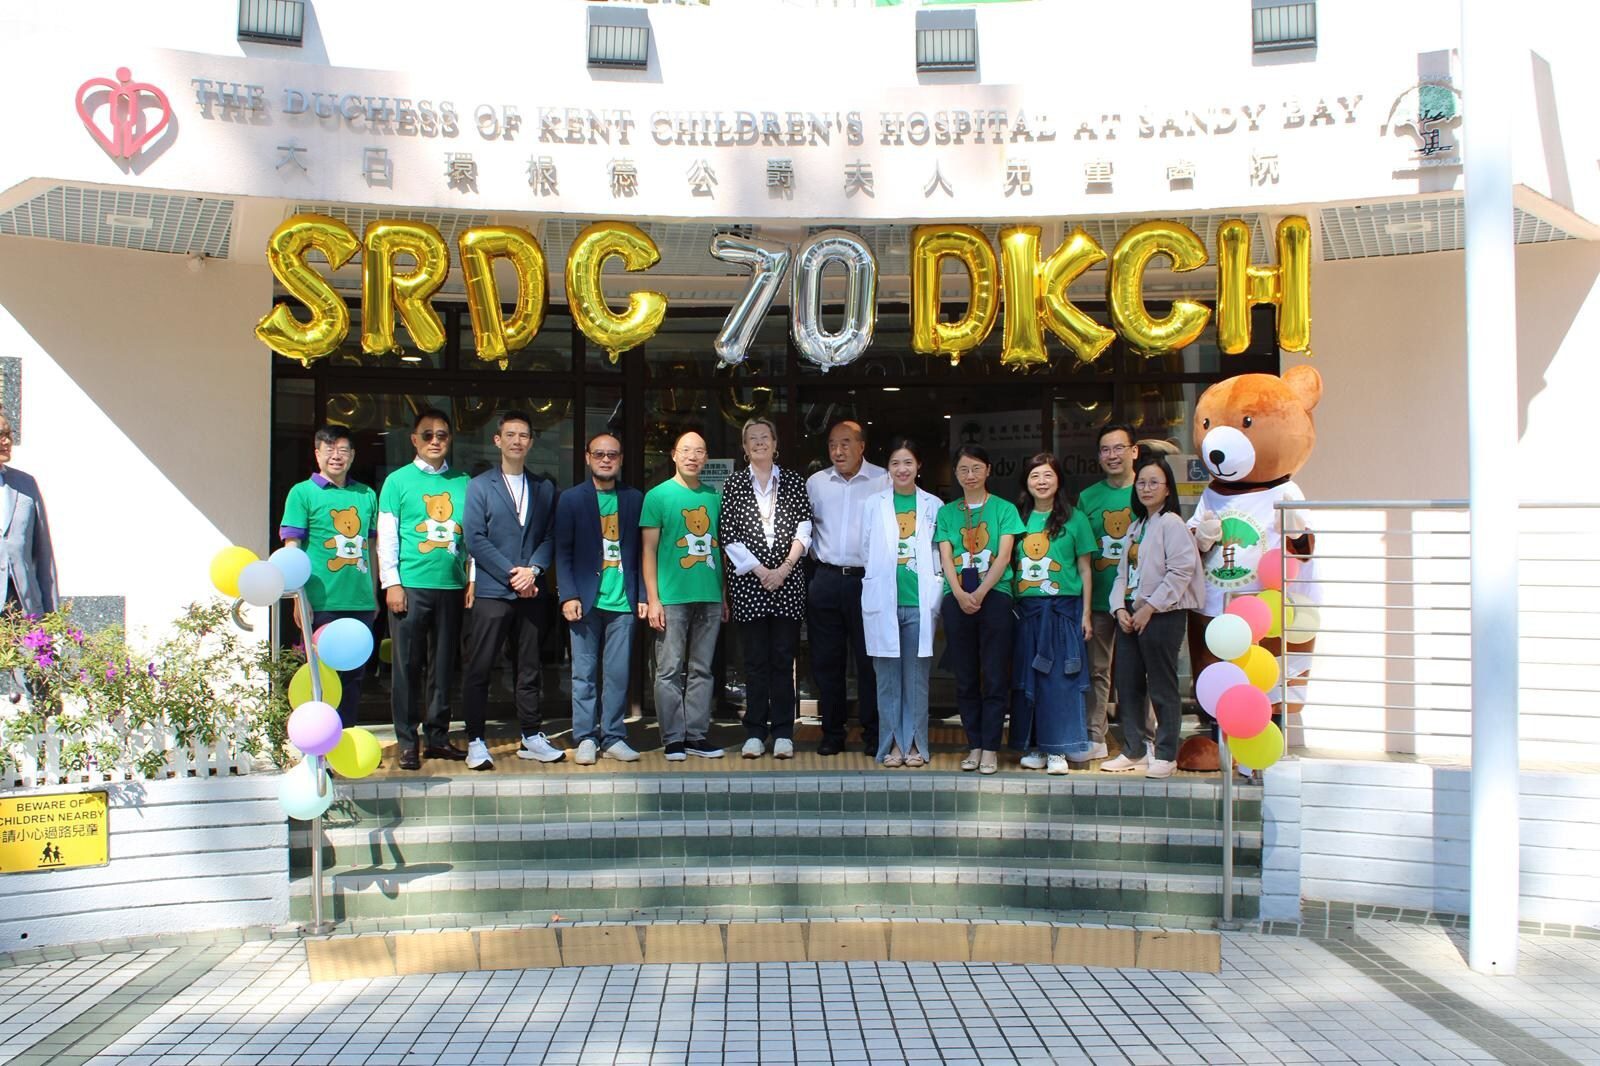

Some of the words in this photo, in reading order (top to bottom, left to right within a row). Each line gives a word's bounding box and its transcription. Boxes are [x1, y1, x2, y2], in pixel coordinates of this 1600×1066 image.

[191, 77, 267, 119] THE
[283, 87, 459, 132] DUCHESS
[473, 104, 522, 139] OF
[536, 107, 636, 140] KENT
[650, 110, 865, 143] CHILDREN'S
[878, 109, 1057, 143] HOSPITAL
[1073, 110, 1121, 140] AT
[1137, 104, 1267, 139] SANDY
[1282, 94, 1363, 130] BAY
[709, 227, 878, 370] 70
[911, 214, 1312, 366] DKCH
[16, 800, 66, 812] BEWARE
[69, 798, 85, 808] OF
[58, 810, 104, 822] NEARBY
[2, 823, 98, 843] 請小心過路兒童
